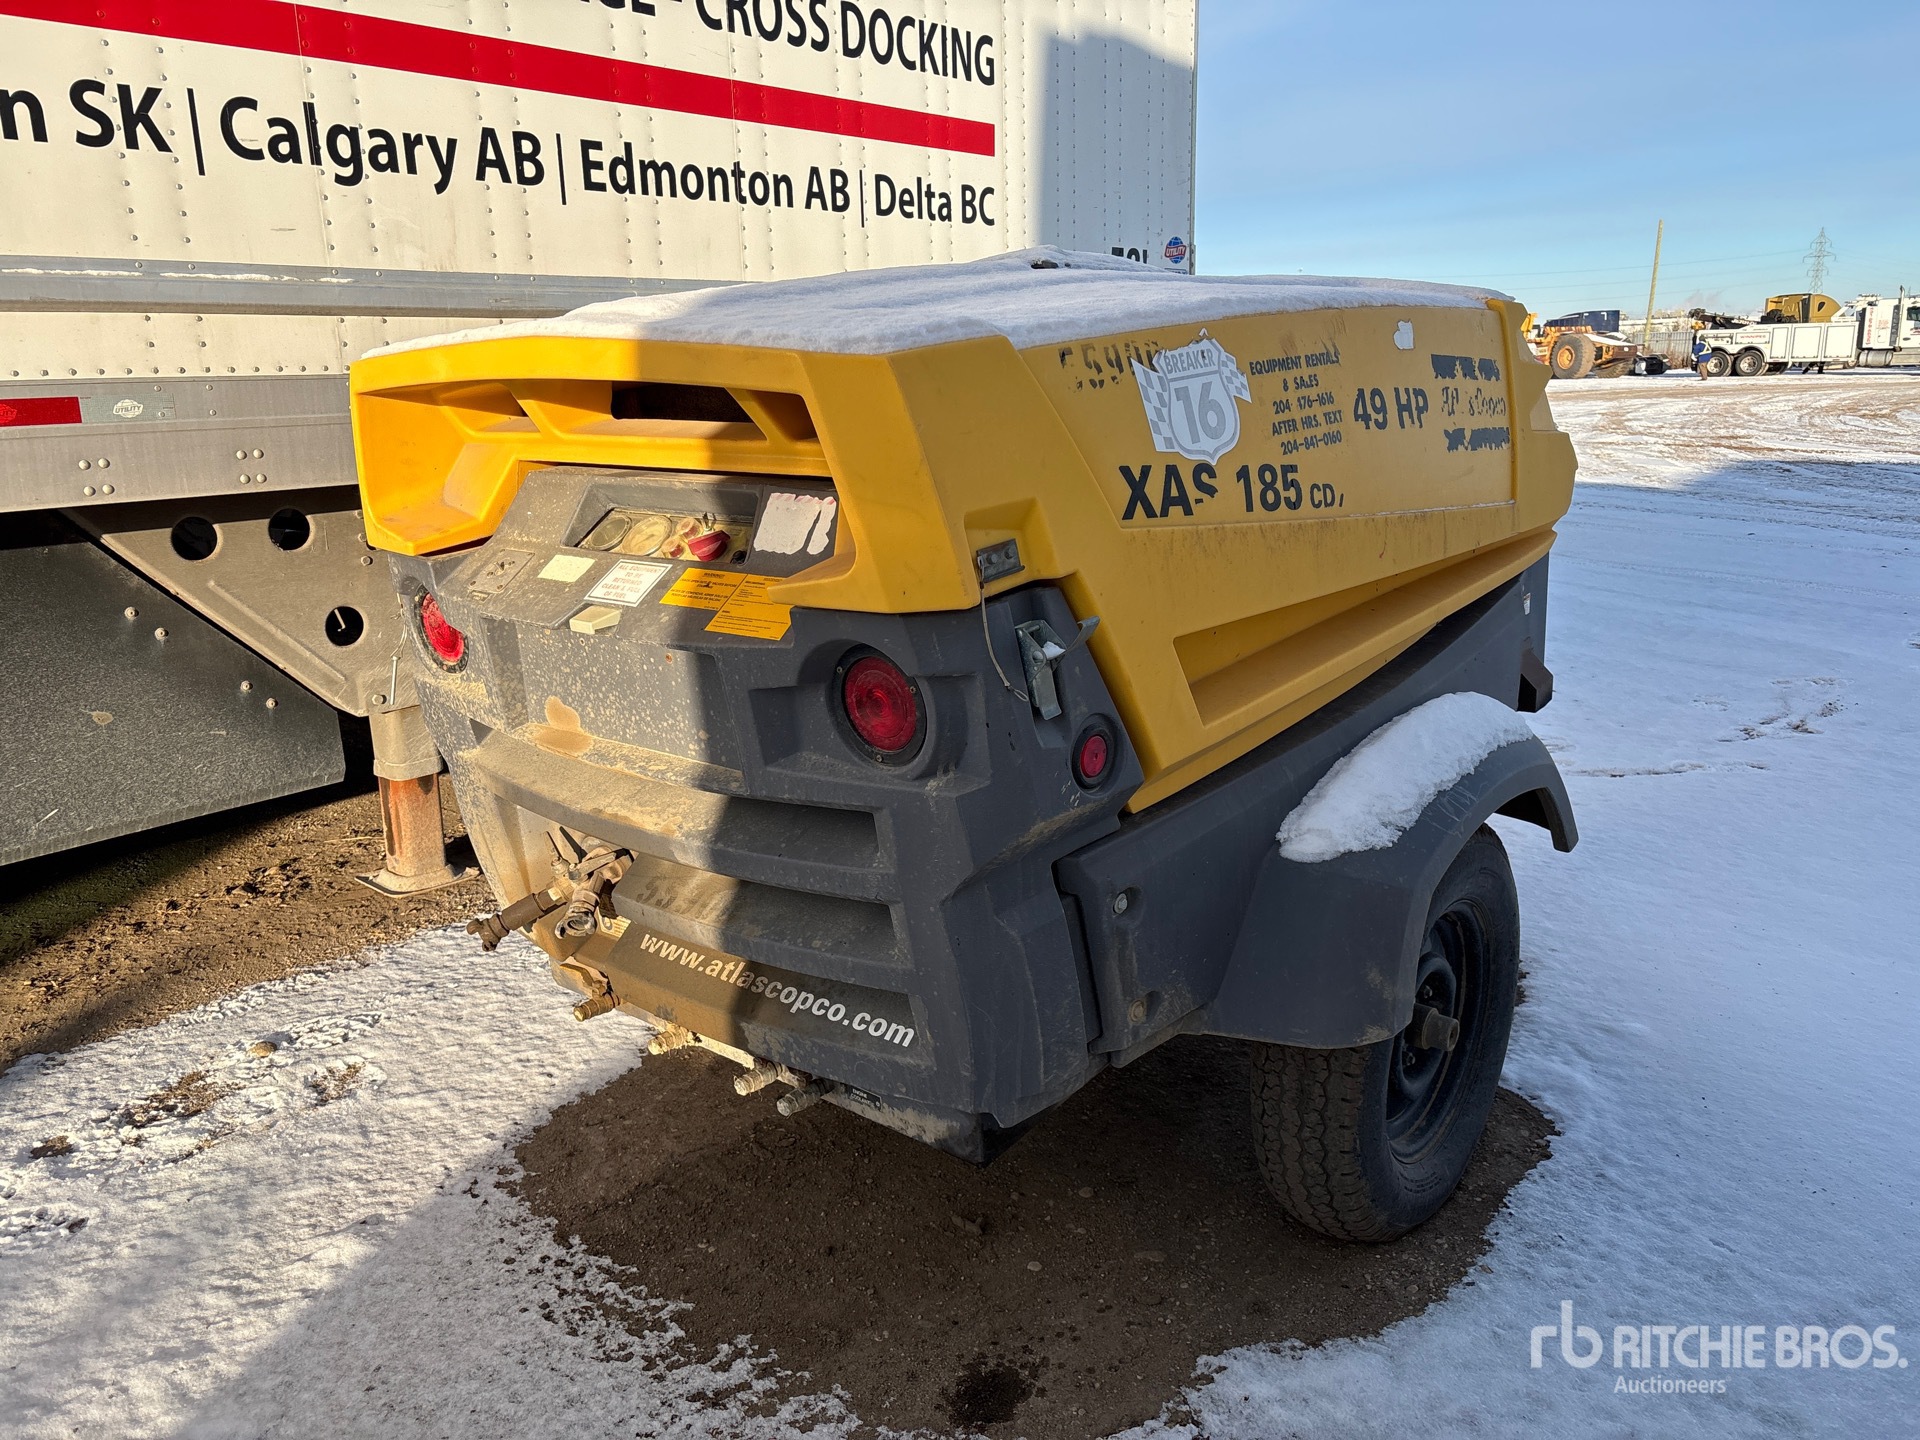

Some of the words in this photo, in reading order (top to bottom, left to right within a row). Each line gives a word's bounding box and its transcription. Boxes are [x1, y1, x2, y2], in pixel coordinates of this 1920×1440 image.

[841, 1, 995, 86] DOCKING
[69, 78, 173, 154] SK
[219, 96, 457, 195] Calgary
[475, 127, 545, 187] AB
[580, 139, 794, 209] Edmonton
[805, 166, 850, 213] AB
[875, 173, 952, 223] Delta
[961, 184, 996, 226] BC
[1166, 246, 1186, 256] UTILITY
[1164, 348, 1216, 374] BREAKER
[1249, 355, 1302, 376] EQUIPMENT
[1305, 351, 1340, 368] RENTALS
[115, 404, 143, 414] UTILITY
[1173, 381, 1226, 444] 16
[1272, 419, 1298, 436] AFTER
[1323, 410, 1342, 425] TEXT
[1353, 388, 1388, 430] 49
[1393, 387, 1429, 429] HP
[1281, 430, 1342, 455] 204-841-0160
[1118, 463, 1218, 520] XAS
[1236, 464, 1302, 513] 185
[639, 932, 915, 1047] www.atlascopco.com
